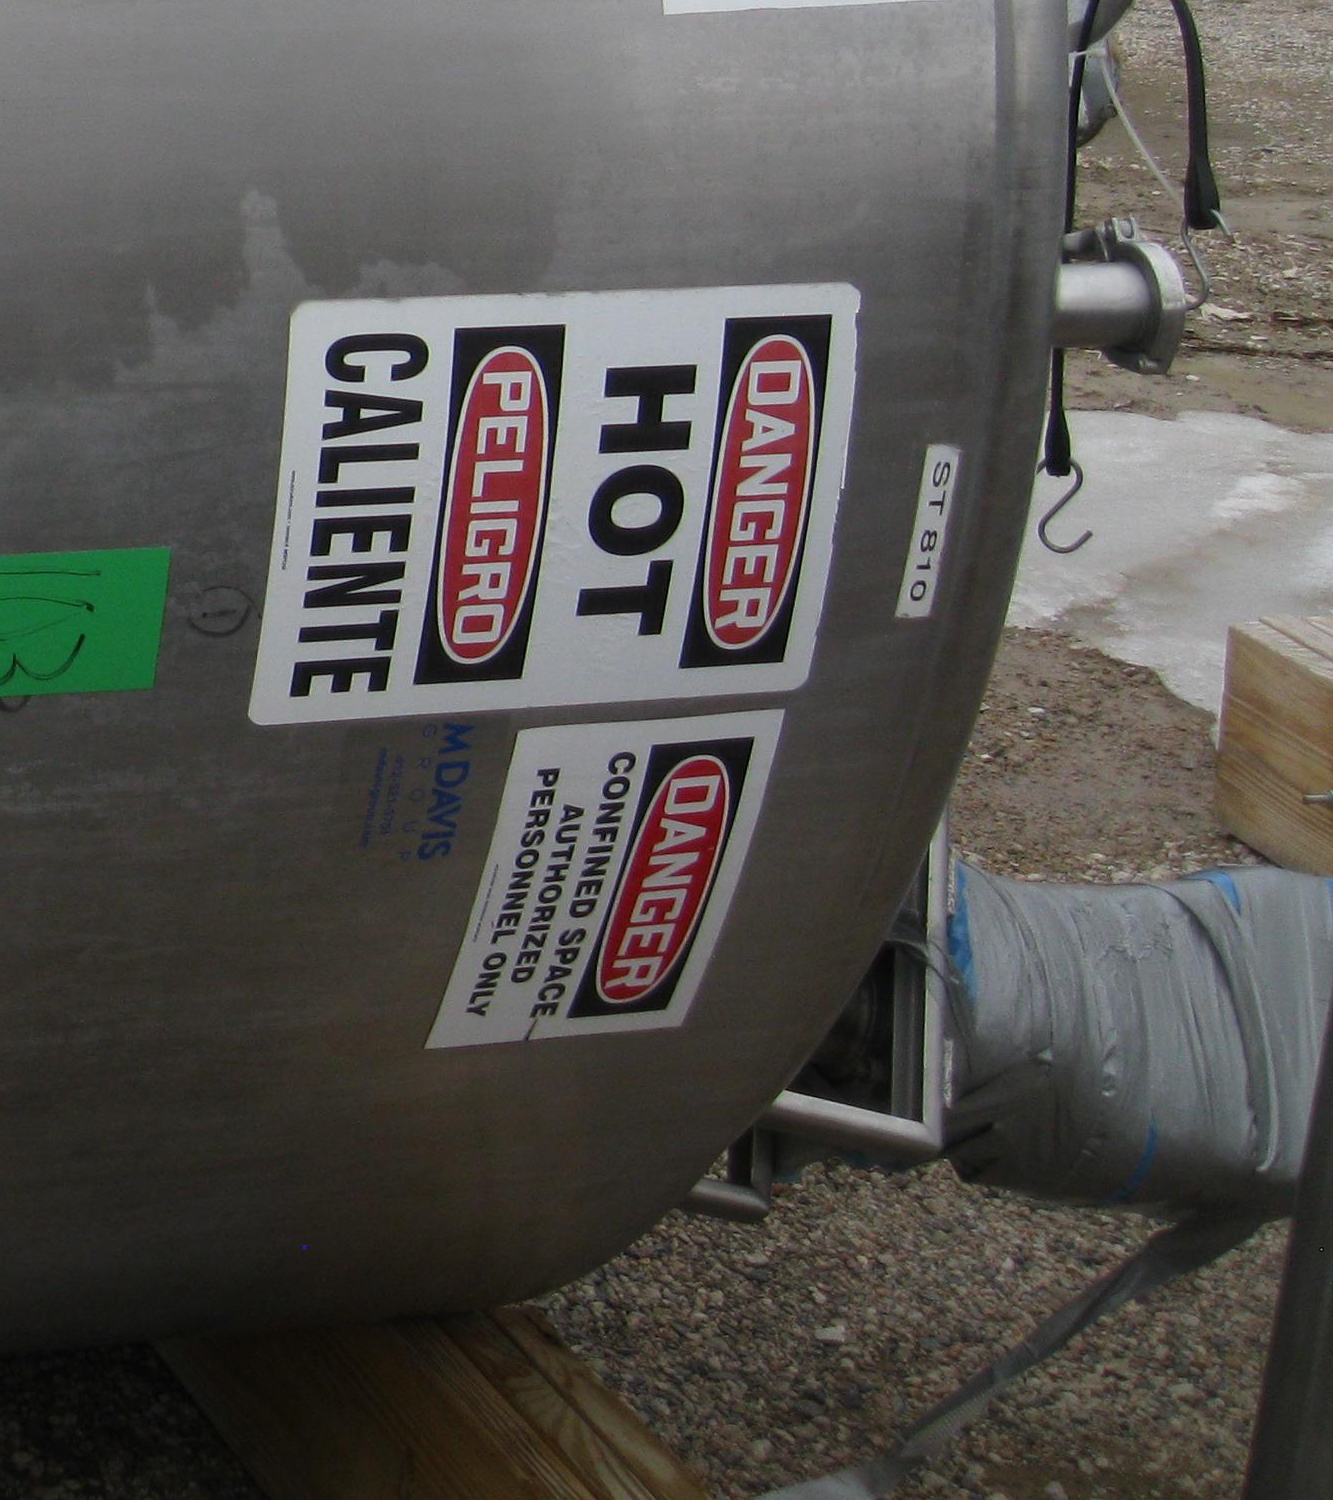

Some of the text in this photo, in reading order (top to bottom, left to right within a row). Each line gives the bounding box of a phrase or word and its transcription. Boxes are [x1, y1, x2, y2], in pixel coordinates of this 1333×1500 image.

[289, 332, 429, 698] CALIENTE
[452, 371, 532, 644] PELIGRO
[575, 364, 698, 636] HOT
[714, 359, 802, 629] DANGER
[909, 460, 951, 601] ST 810
[490, 767, 561, 945] PERSONNEL
[510, 803, 584, 984] AUTHORIZED
[529, 751, 636, 1019] CONFINED SPACE
[604, 775, 721, 990] DANGER
[465, 952, 507, 1017] ONLY
